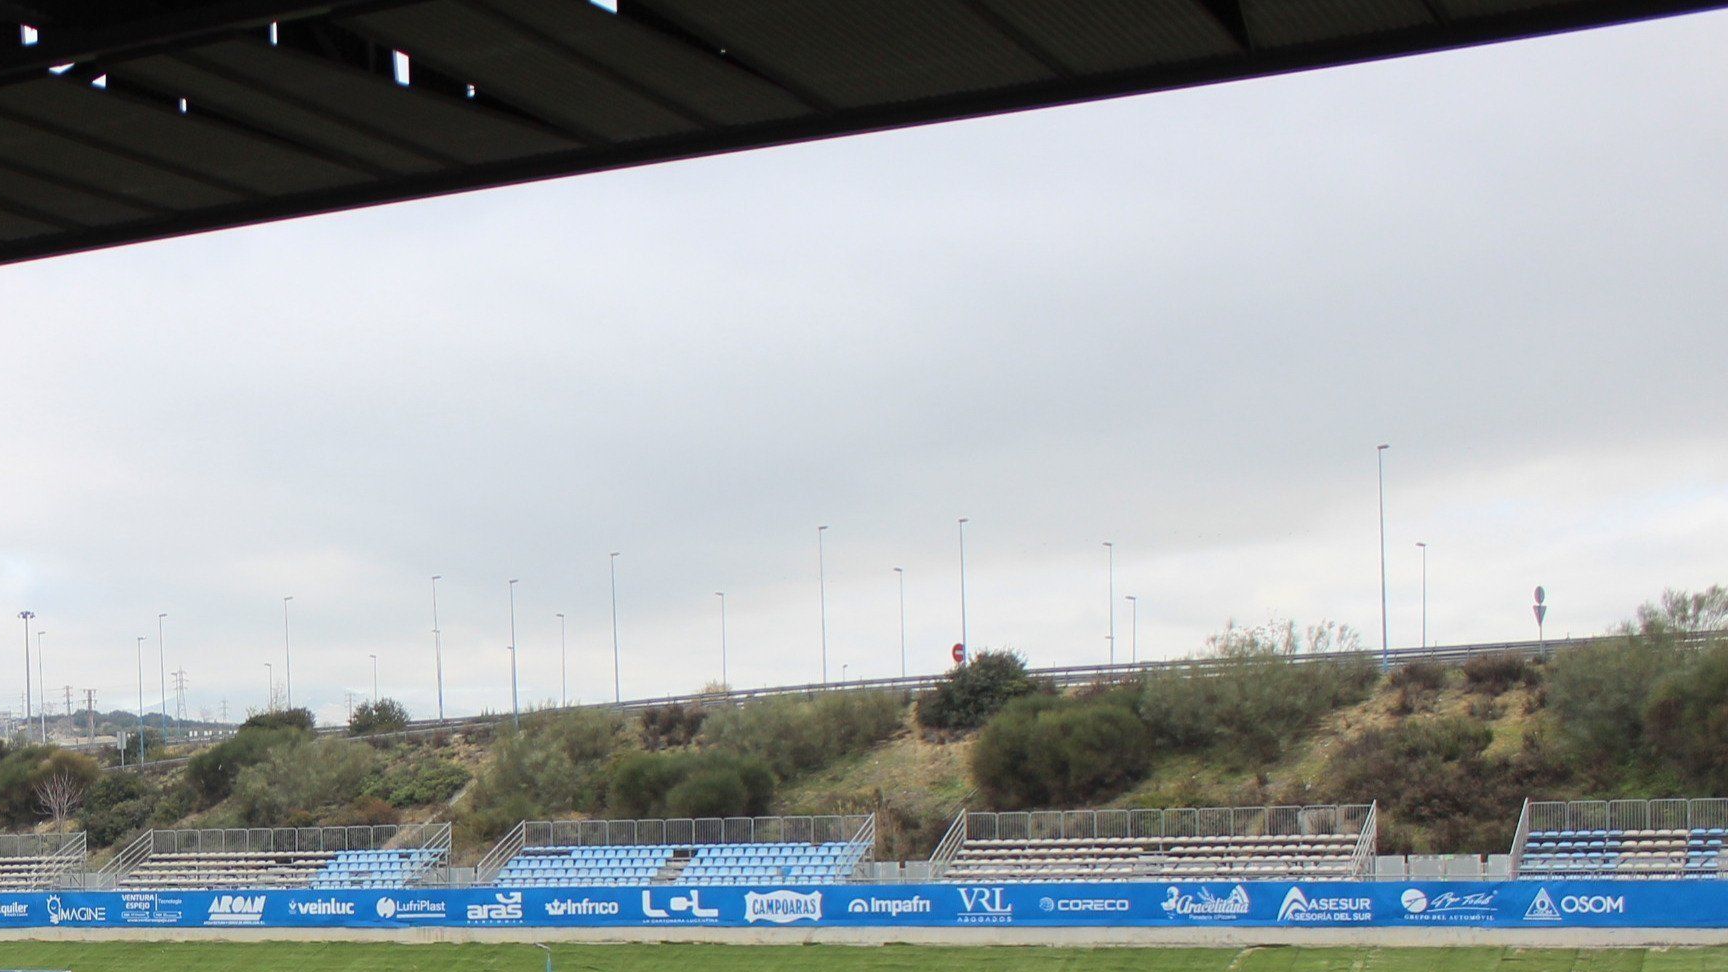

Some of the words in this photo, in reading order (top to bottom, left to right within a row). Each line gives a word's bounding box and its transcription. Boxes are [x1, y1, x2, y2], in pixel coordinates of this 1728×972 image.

[125, 902, 150, 910] ESPEJO
[208, 895, 266, 913] AROAN
[298, 898, 354, 915] veinluc
[396, 900, 445, 911] LufriPlast
[567, 898, 619, 914] Infrico
[752, 899, 816, 915] CAMPOARAS
[871, 895, 930, 916] Impafri
[957, 887, 1012, 912] VRL
[1057, 899, 1129, 911] CORECO
[1305, 898, 1370, 911] ASESUR
[1561, 896, 1623, 914] OSOM
[58, 906, 106, 921] IMAGINE
[467, 904, 522, 919] aras
[1288, 911, 1332, 921] ASESORÍA
[1334, 913, 1350, 921] DEL
[1352, 912, 1371, 921] SUR
